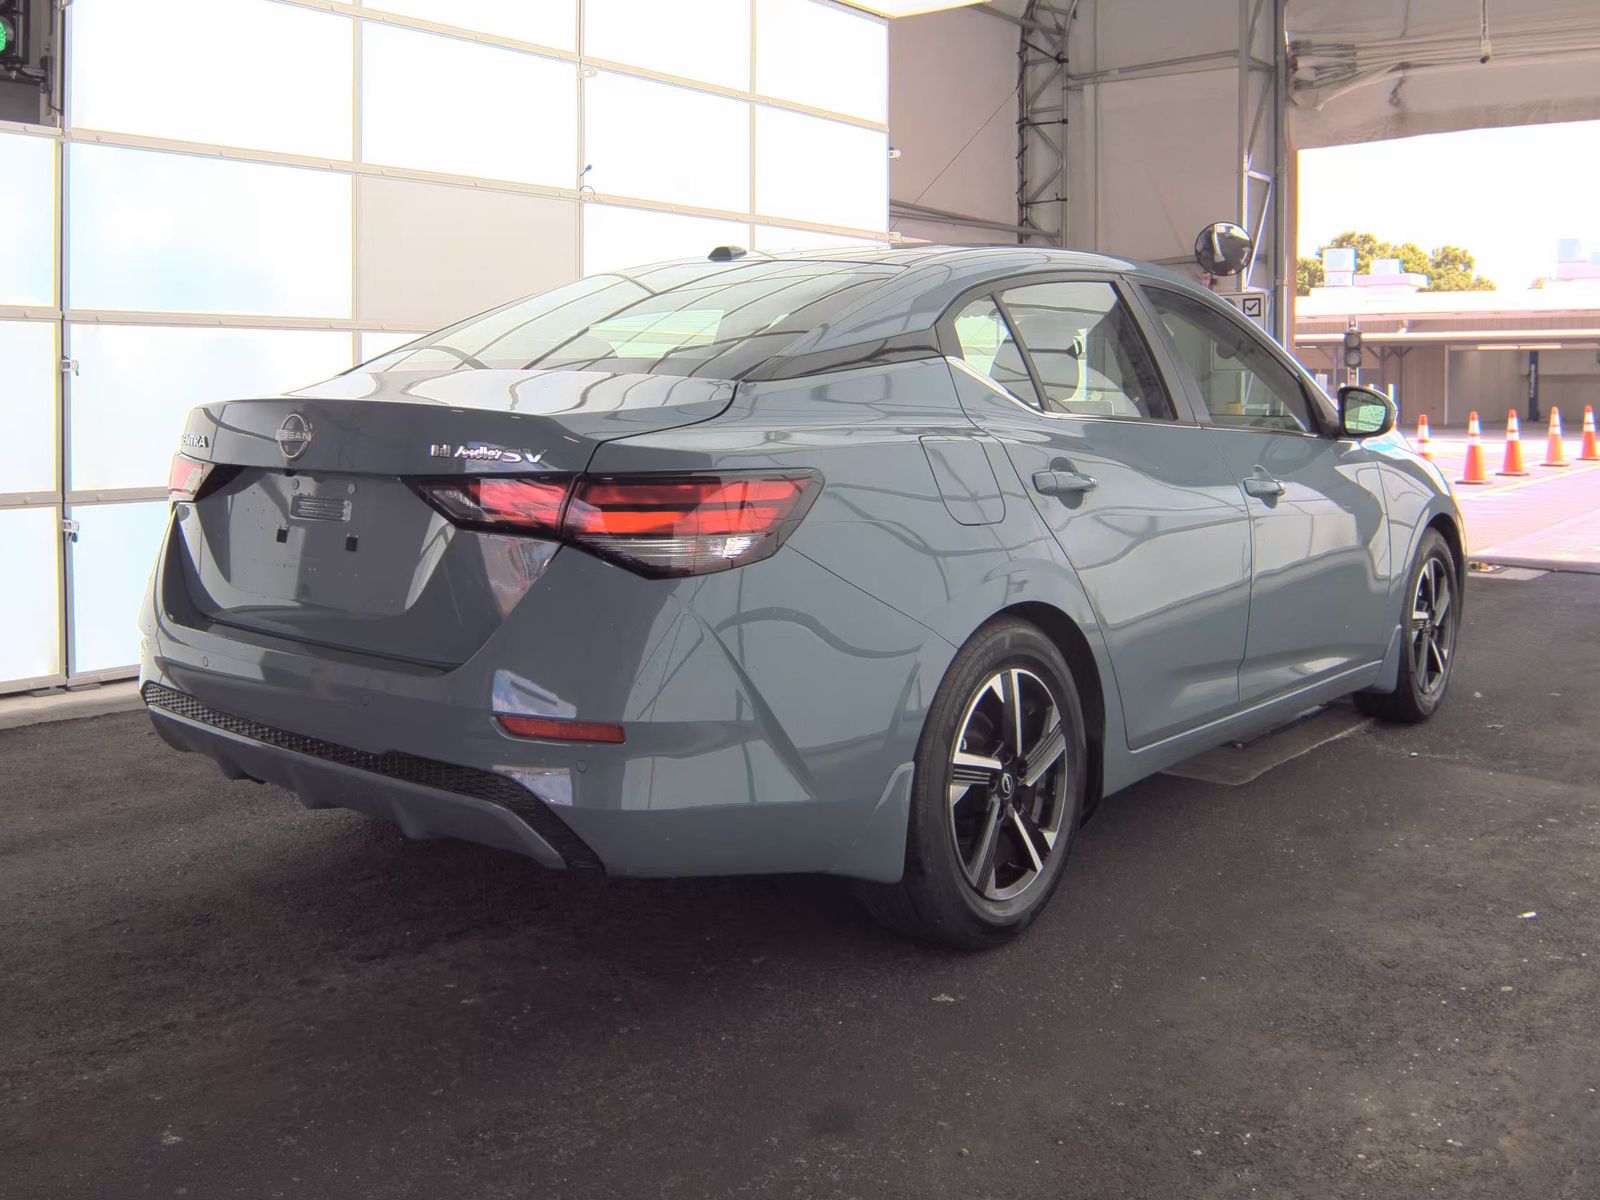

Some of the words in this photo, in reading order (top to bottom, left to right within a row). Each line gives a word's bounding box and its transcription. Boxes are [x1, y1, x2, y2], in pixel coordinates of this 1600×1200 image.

[182, 433, 208, 448] ENTRA
[277, 430, 311, 441] SSAN
[502, 449, 548, 463] SV
